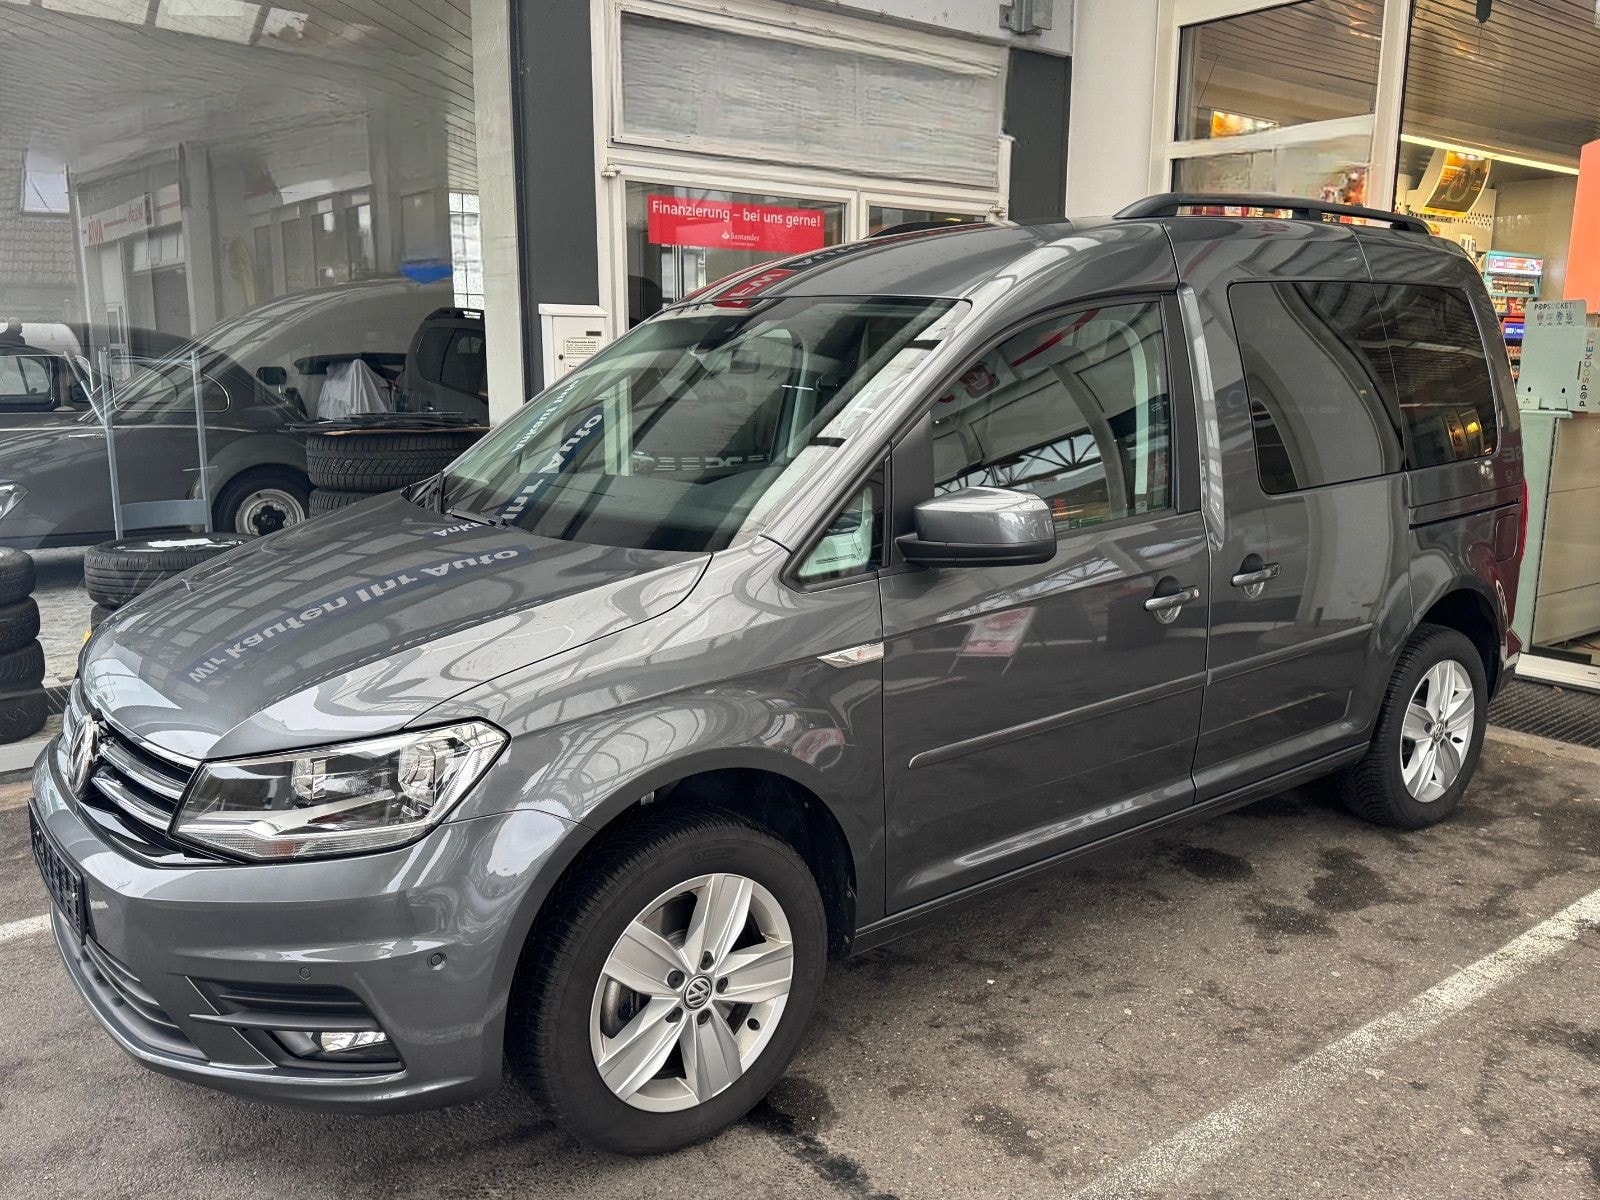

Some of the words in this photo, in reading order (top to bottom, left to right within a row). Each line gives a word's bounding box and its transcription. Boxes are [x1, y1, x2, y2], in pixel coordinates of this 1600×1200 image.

[652, 200, 730, 223] Finanzierung
[743, 209, 760, 222] bei
[763, 213, 783, 224] uns
[786, 215, 821, 228] gerne!
[730, 231, 760, 242] Santander
[1579, 331, 1595, 407] POPSOCKETS
